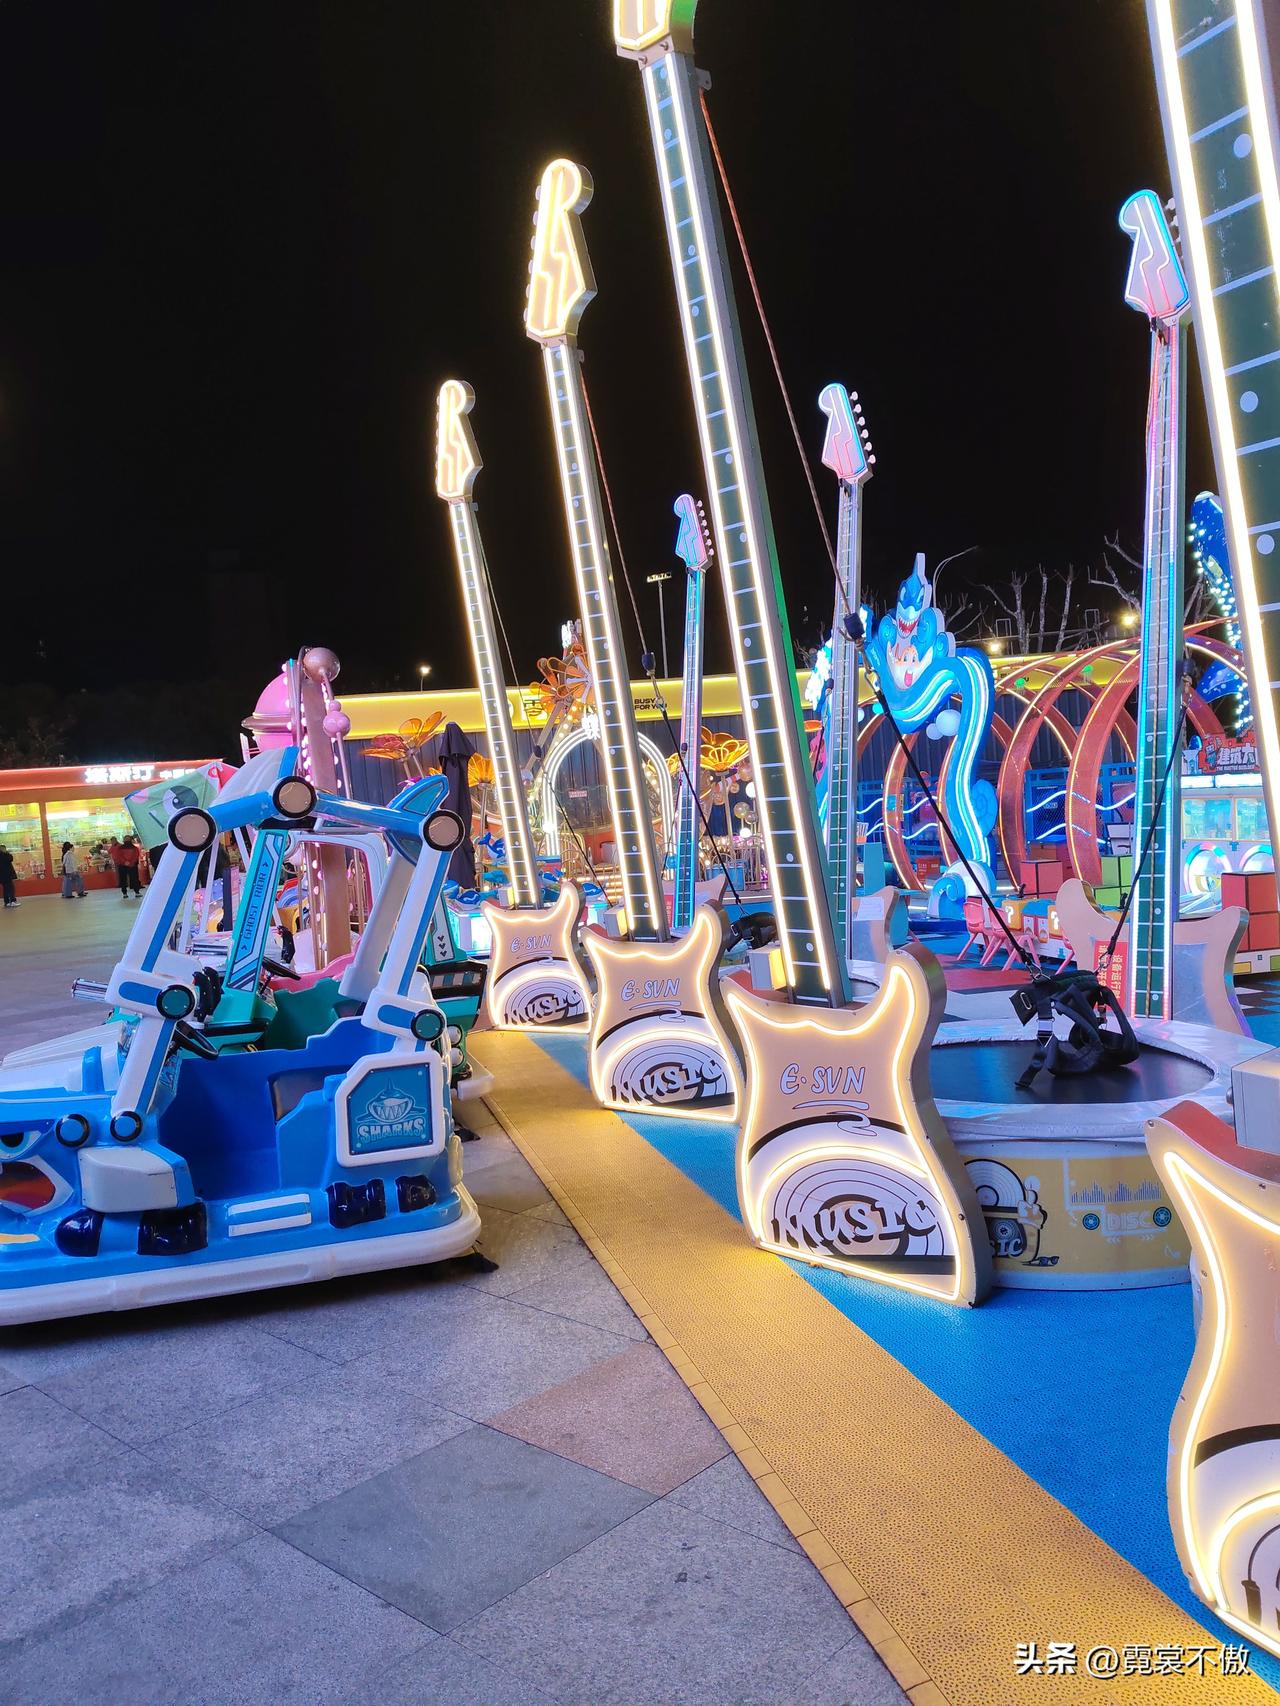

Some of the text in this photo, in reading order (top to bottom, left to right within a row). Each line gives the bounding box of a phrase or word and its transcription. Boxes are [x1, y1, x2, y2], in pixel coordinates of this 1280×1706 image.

[1217, 743, 1260, 766] 建筑大
[244, 905, 258, 940] GHOST
[504, 990, 582, 1025] MUSIC
[610, 1059, 724, 1104] MUSIC
[358, 1118, 424, 1141] SHARKS
[771, 1199, 936, 1252] MUSIC
[1107, 1211, 1152, 1231] DISC
